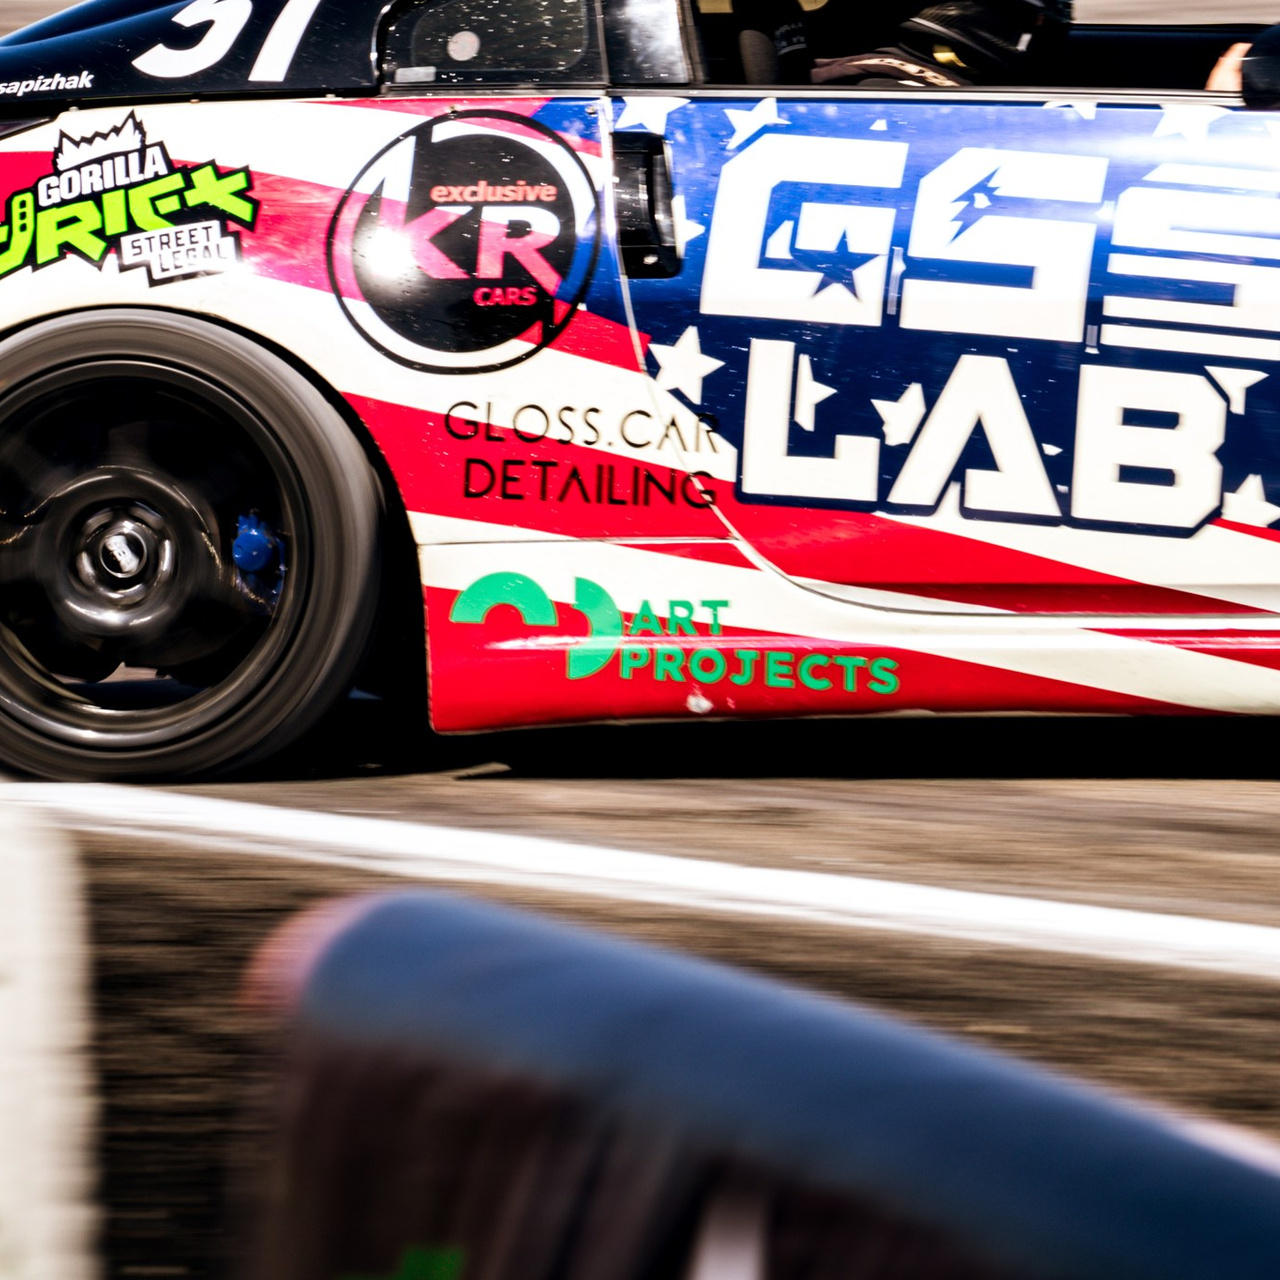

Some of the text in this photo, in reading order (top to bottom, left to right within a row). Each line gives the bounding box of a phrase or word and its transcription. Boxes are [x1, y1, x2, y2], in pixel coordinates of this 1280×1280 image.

[0, 70, 95, 97] sapizhak
[38, 145, 169, 207] GORILLA
[430, 180, 558, 202] exclusive
[131, 226, 213, 257] STREET
[159, 243, 228, 273] LEGAL
[473, 287, 538, 306] CARS
[742, 338, 1227, 527] LAB
[463, 458, 718, 510] DETAILING
[629, 599, 730, 635] ART
[619, 648, 900, 695] PROJECTS
